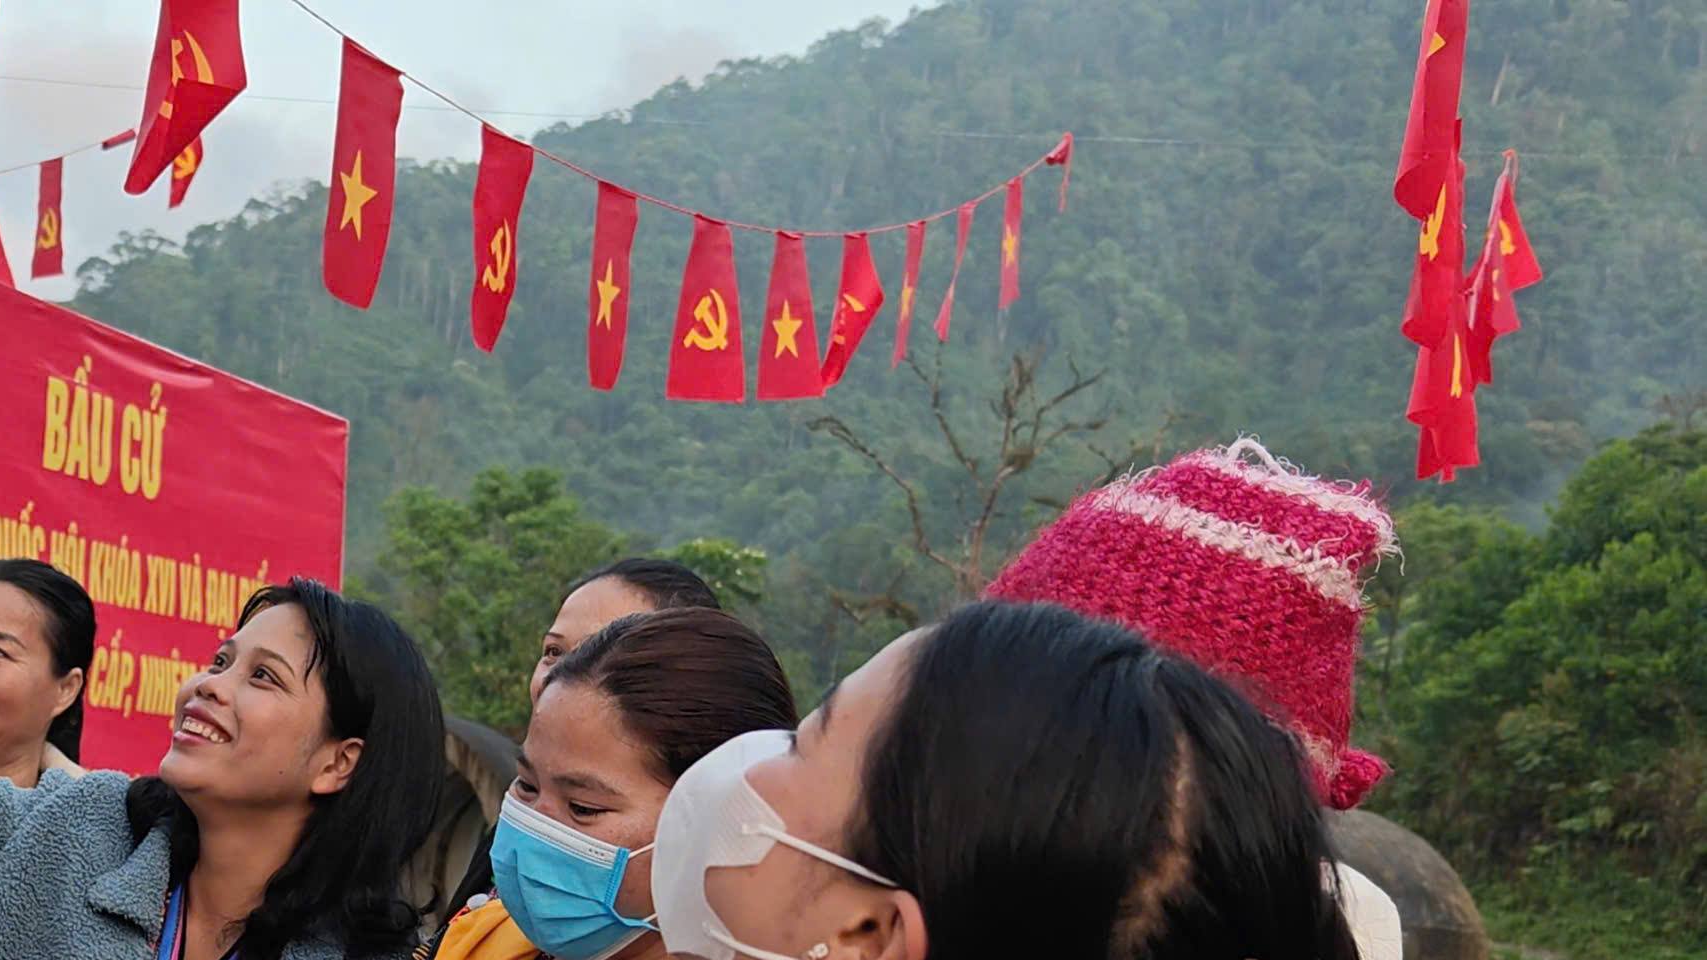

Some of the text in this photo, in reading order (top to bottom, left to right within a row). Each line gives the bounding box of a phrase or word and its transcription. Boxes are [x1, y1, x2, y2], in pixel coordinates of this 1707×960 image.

[43, 355, 167, 500] BẦU CỬ
[89, 534, 141, 610] KHÓA
[144, 554, 177, 617] XVI
[179, 553, 202, 623] VÀ
[205, 567, 236, 641] ĐẠI
[88, 629, 134, 718] CẤP,
